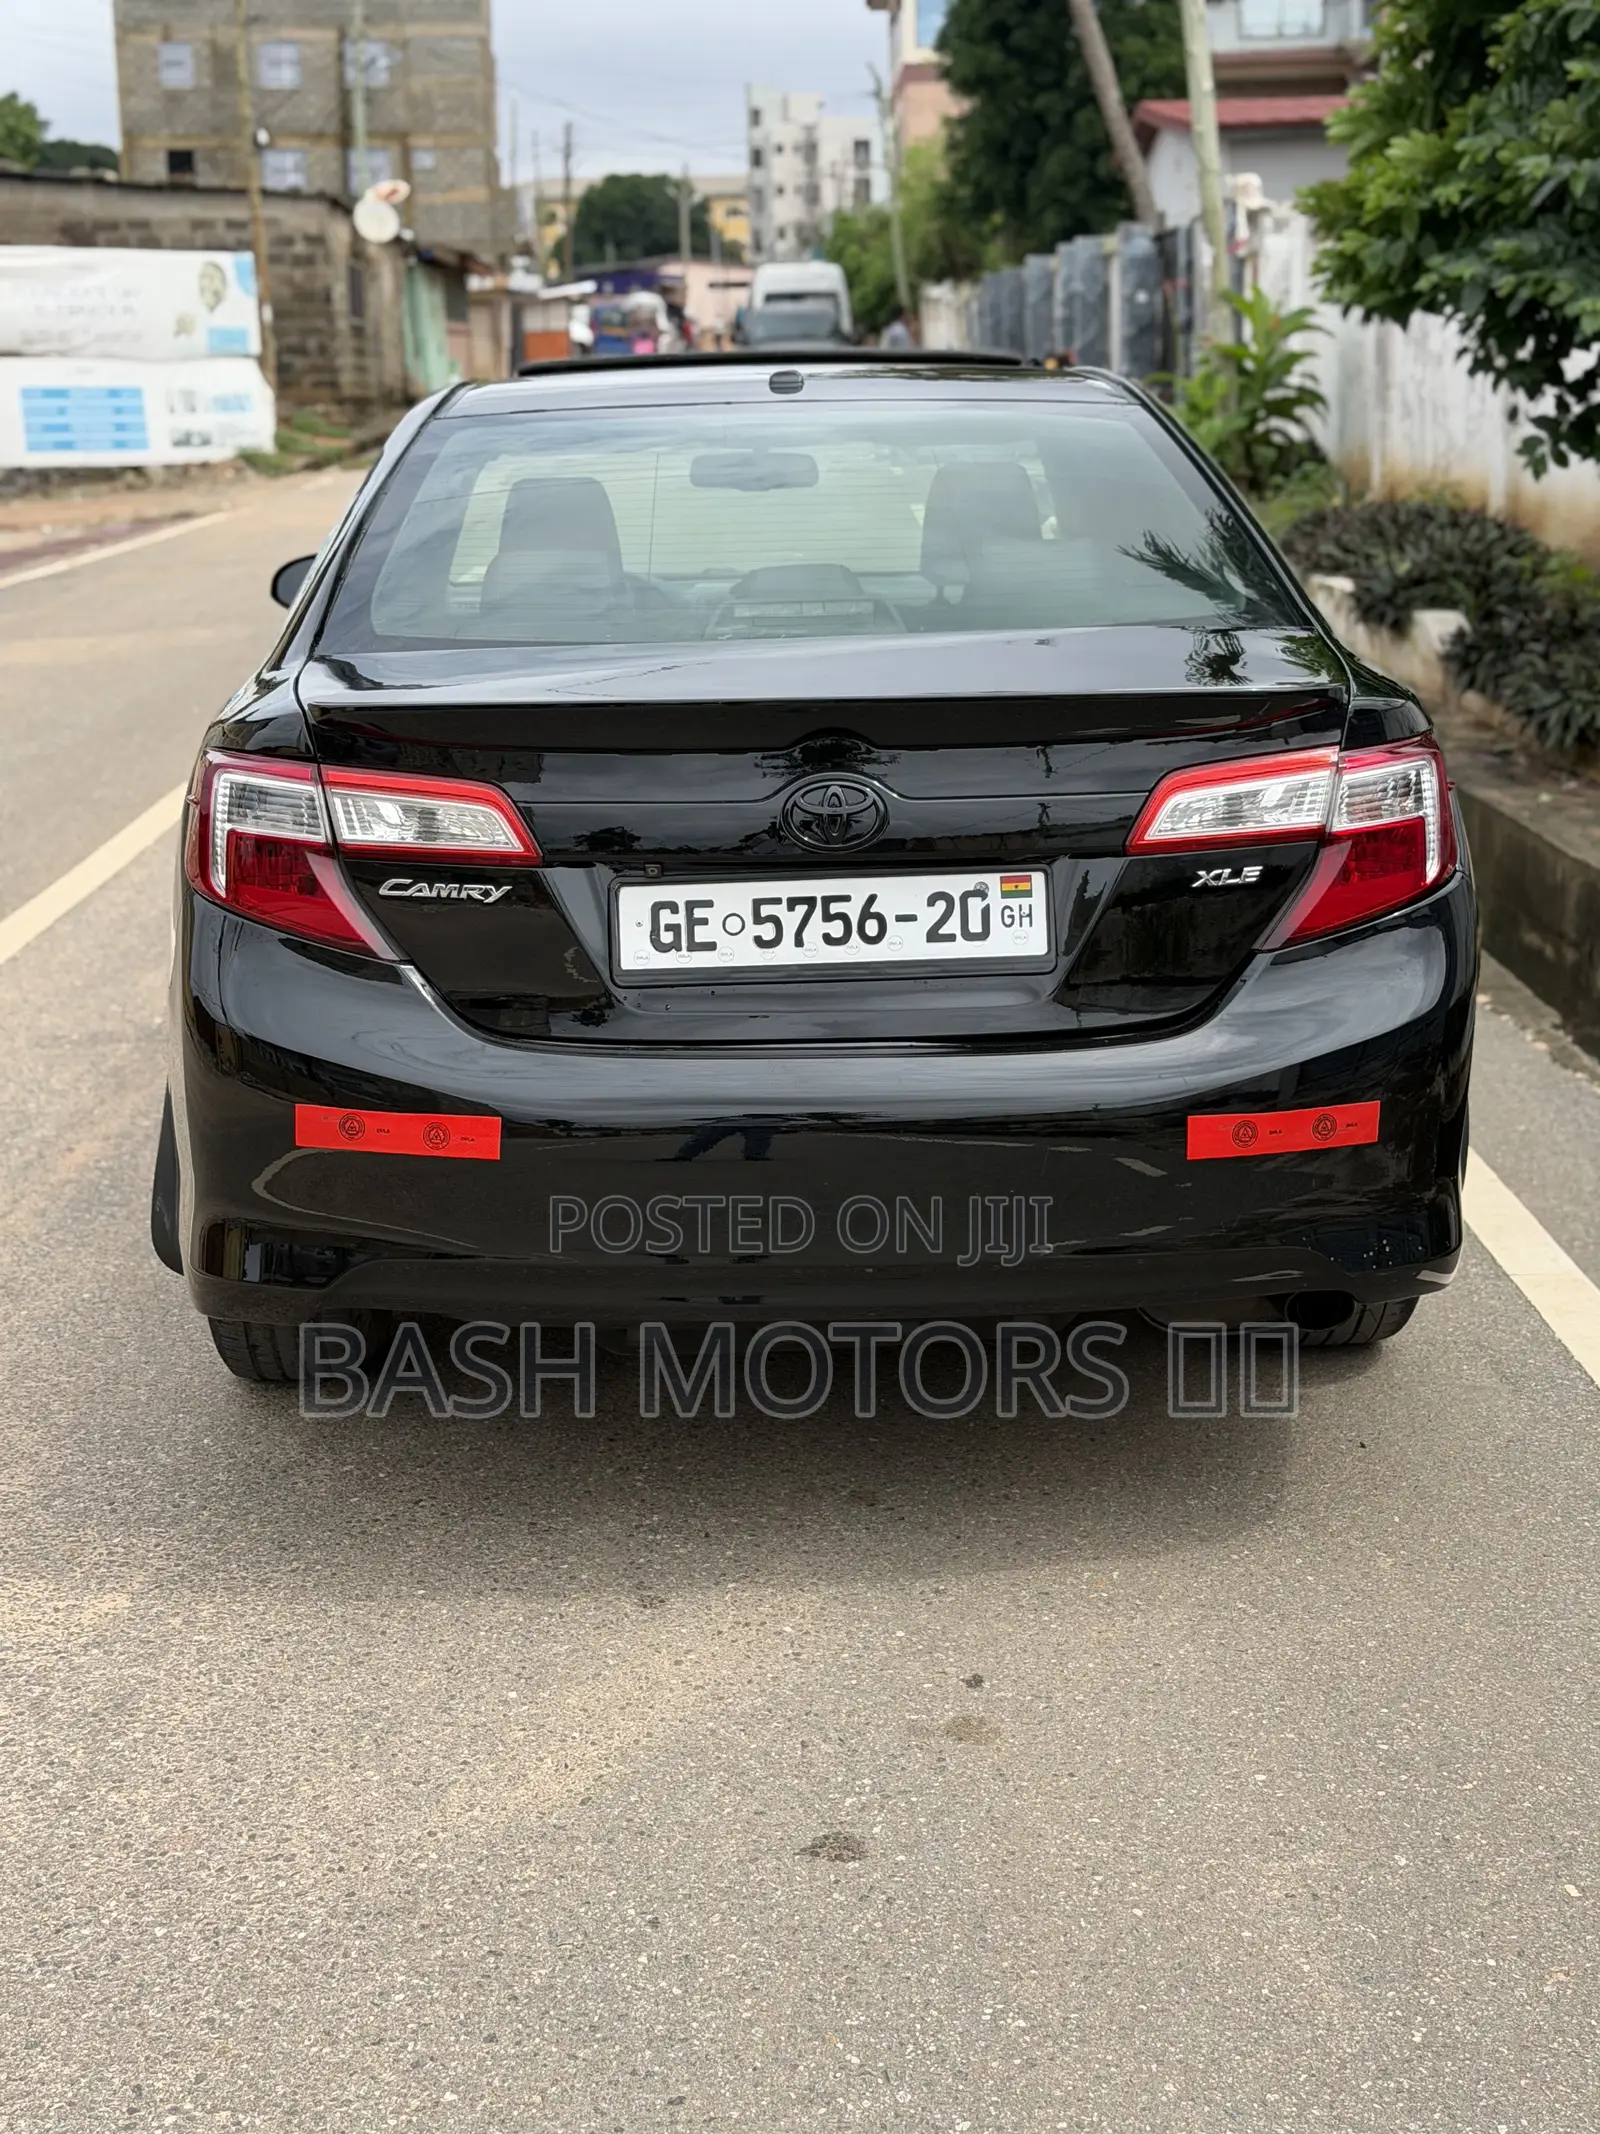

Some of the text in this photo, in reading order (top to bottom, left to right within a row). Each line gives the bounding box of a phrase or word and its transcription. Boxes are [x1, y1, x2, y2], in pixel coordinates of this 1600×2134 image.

[1191, 865, 1263, 887] XLE
[378, 878, 513, 903] CAMRY
[650, 900, 717, 952] GE
[1000, 904, 1033, 928] GH
